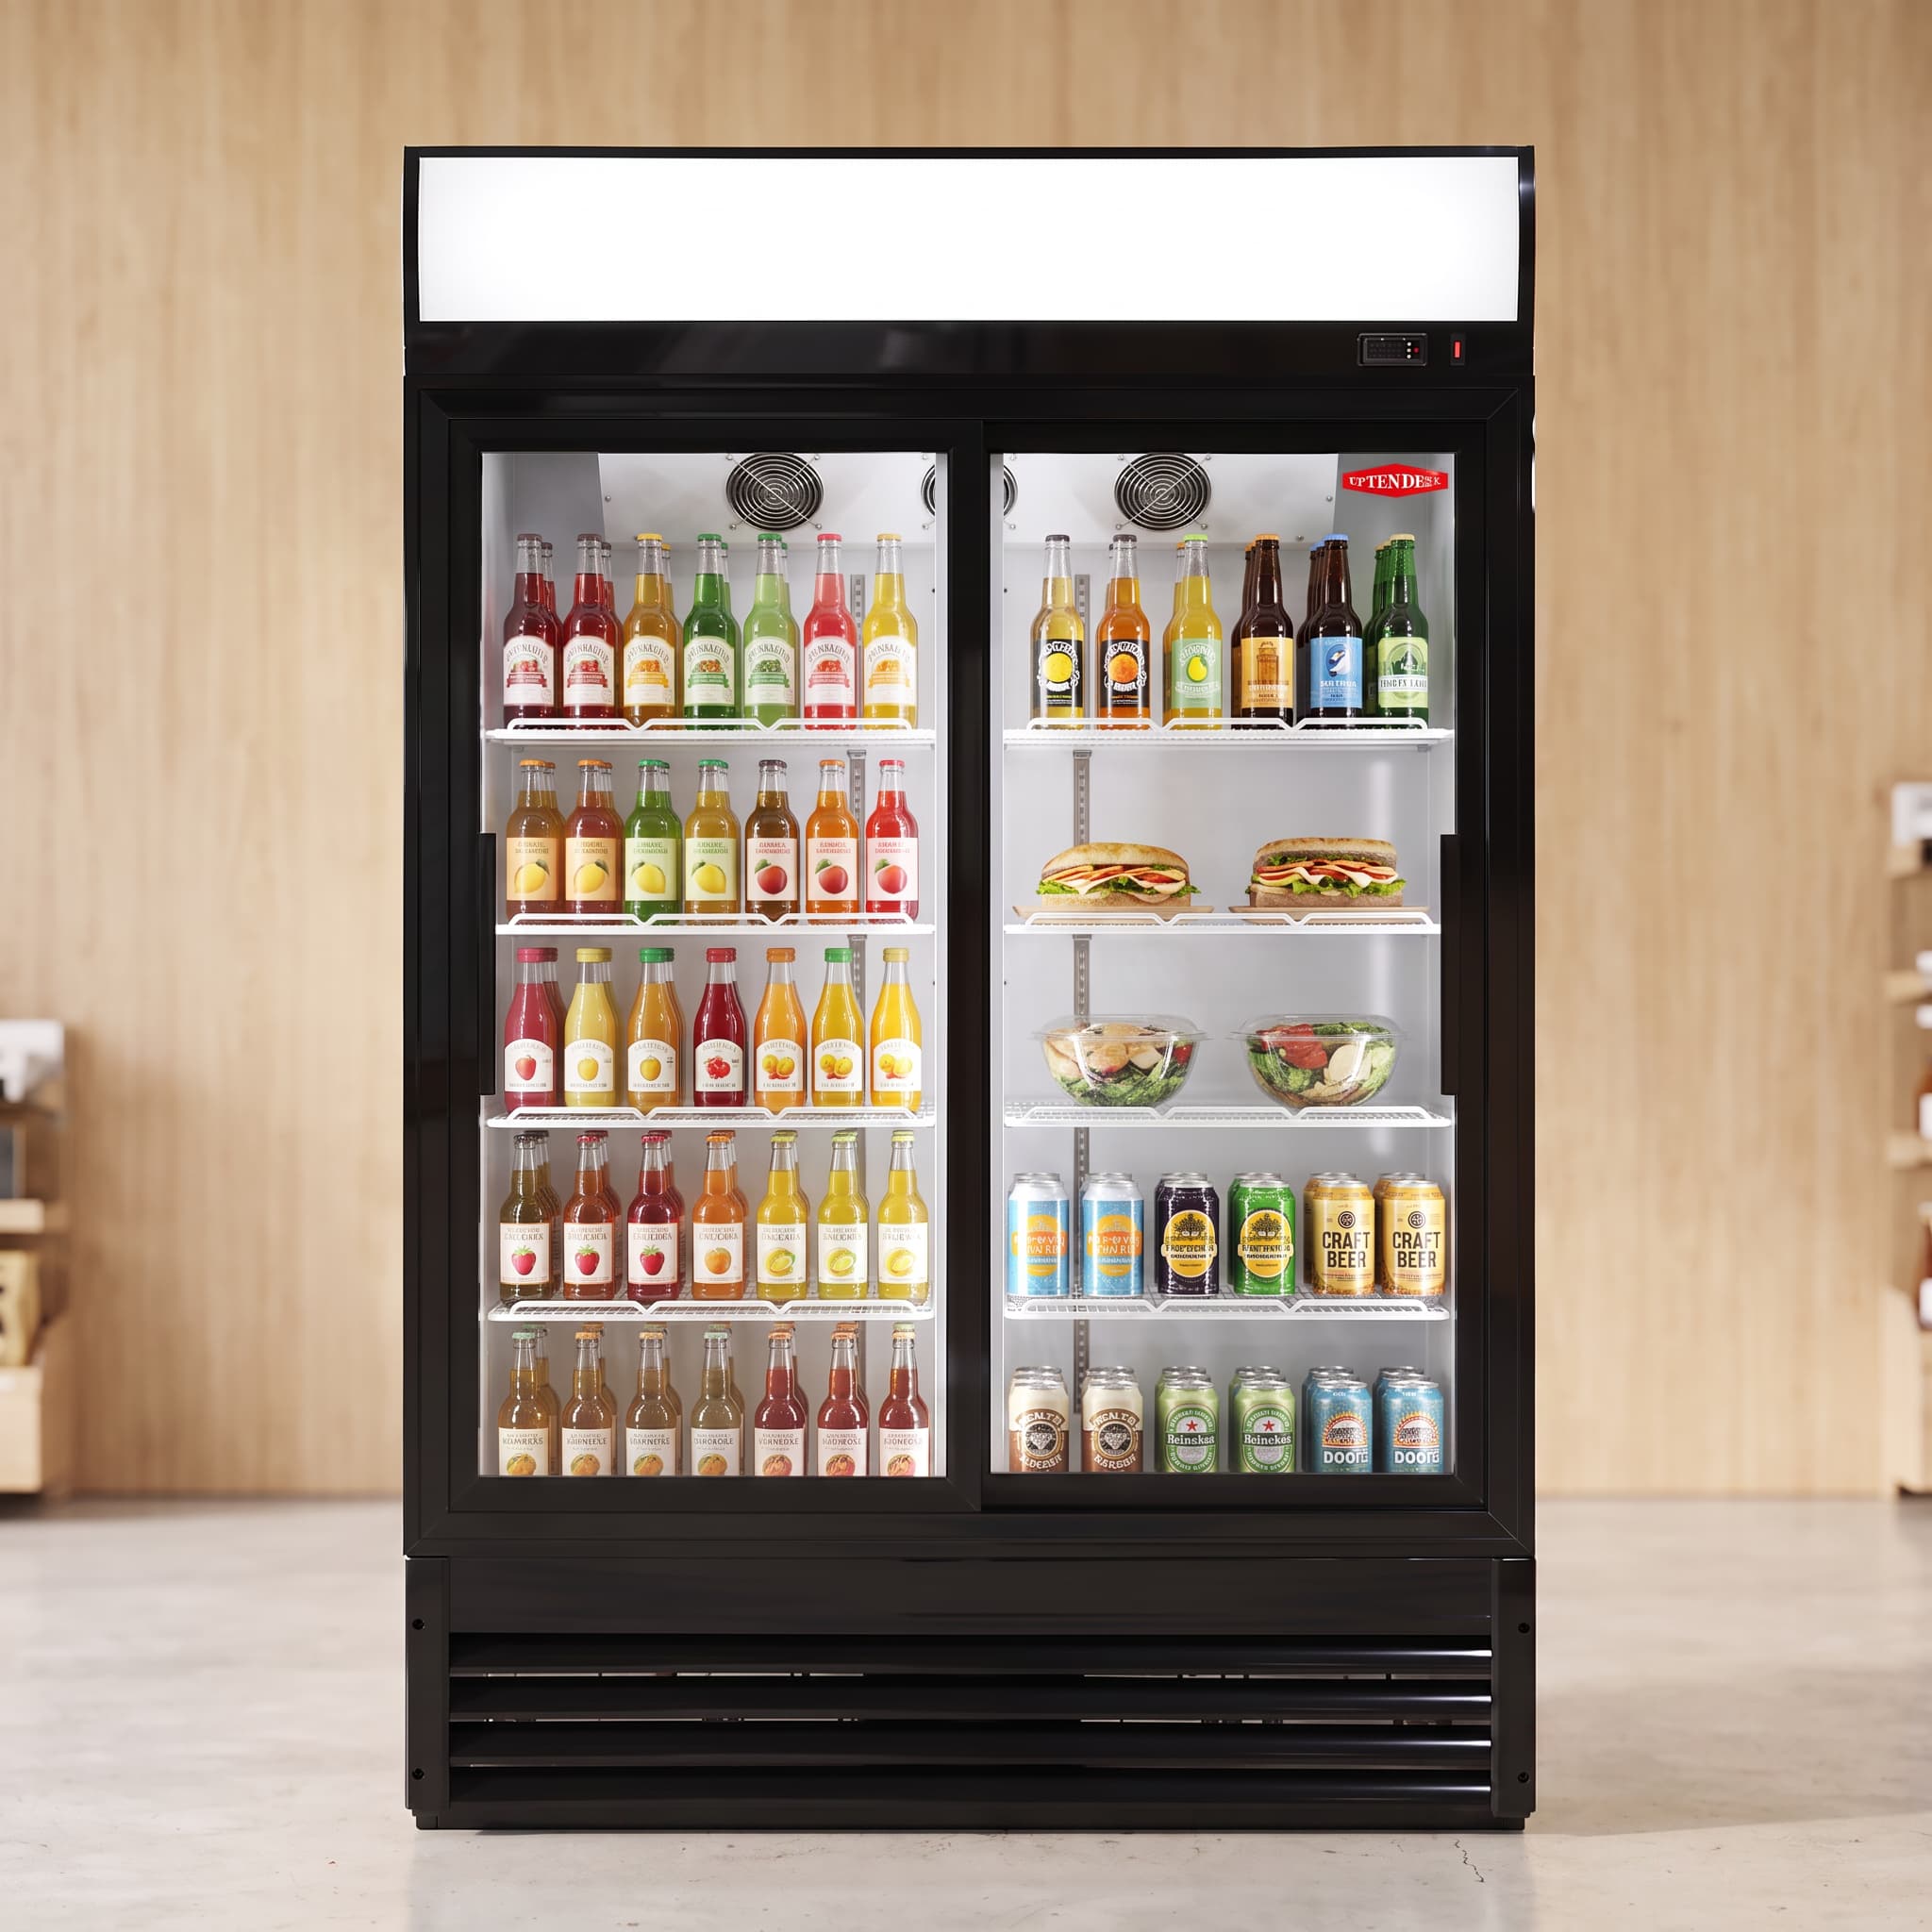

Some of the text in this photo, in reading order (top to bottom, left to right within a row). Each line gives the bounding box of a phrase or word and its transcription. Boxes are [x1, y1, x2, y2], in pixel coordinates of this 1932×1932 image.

[1323, 1231, 1371, 1249] CRAFT
[1392, 1231, 1441, 1249] CRAFT
[1327, 1251, 1367, 1268] BEER
[1397, 1251, 1437, 1268] BEER
